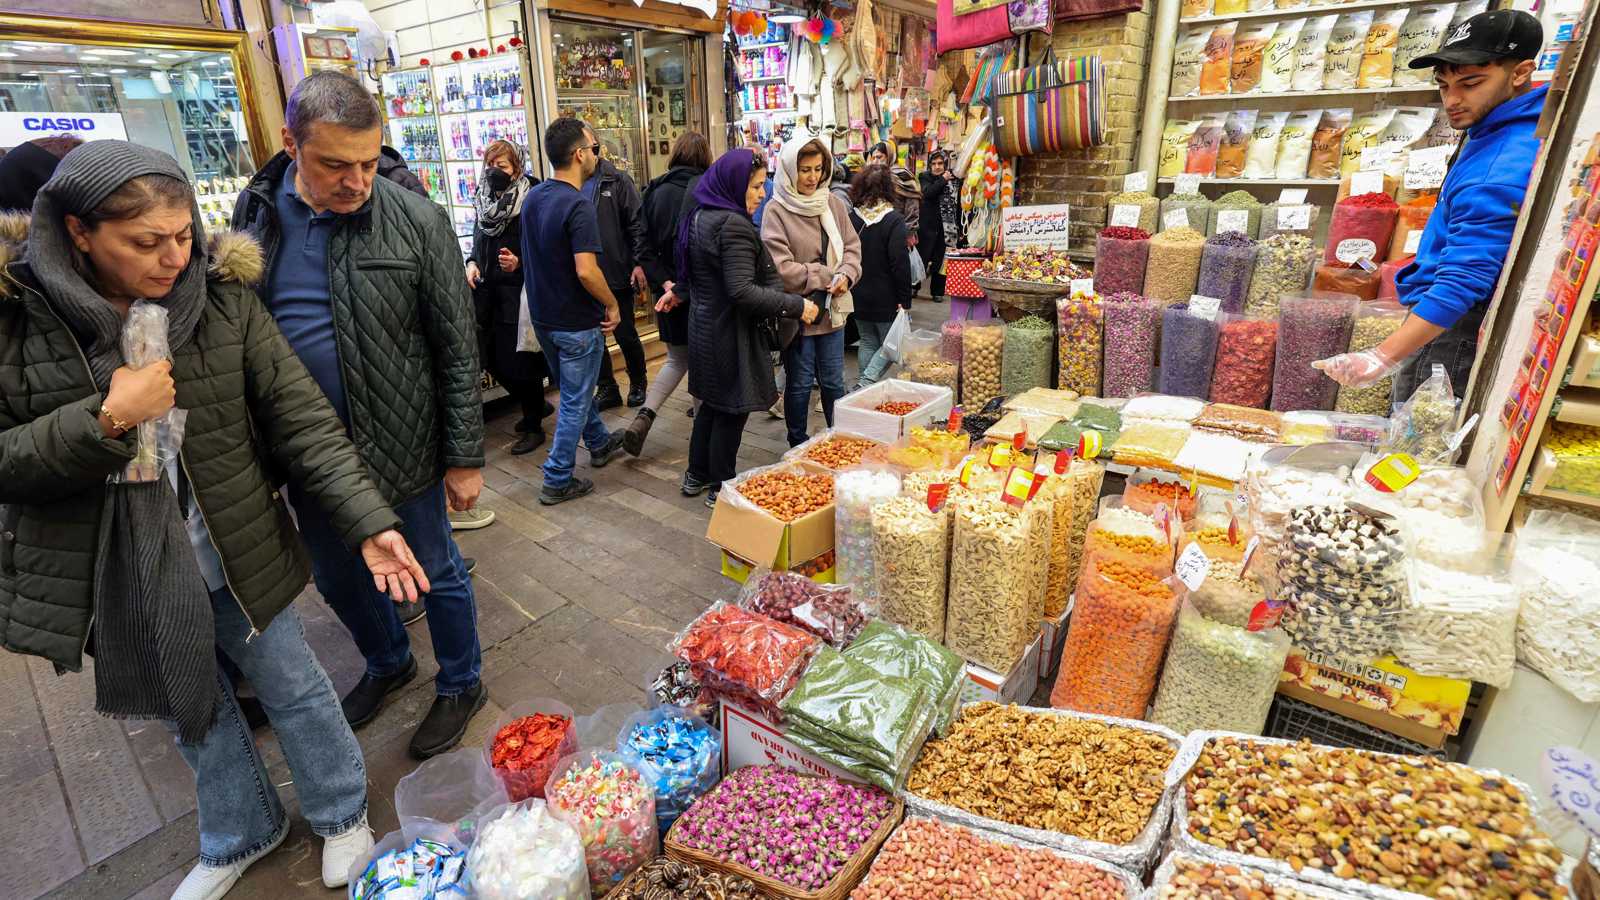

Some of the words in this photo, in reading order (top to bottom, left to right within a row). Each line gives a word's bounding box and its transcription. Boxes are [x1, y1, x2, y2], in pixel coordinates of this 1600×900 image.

[23, 118, 95, 131] CASIO
[1005, 212, 1023, 222] گیاهی
[1044, 211, 1066, 220] دمنوش
[1318, 668, 1381, 693] NATURAL
[751, 731, 784, 753] BRAND
[787, 749, 833, 778] AHLEVAN
